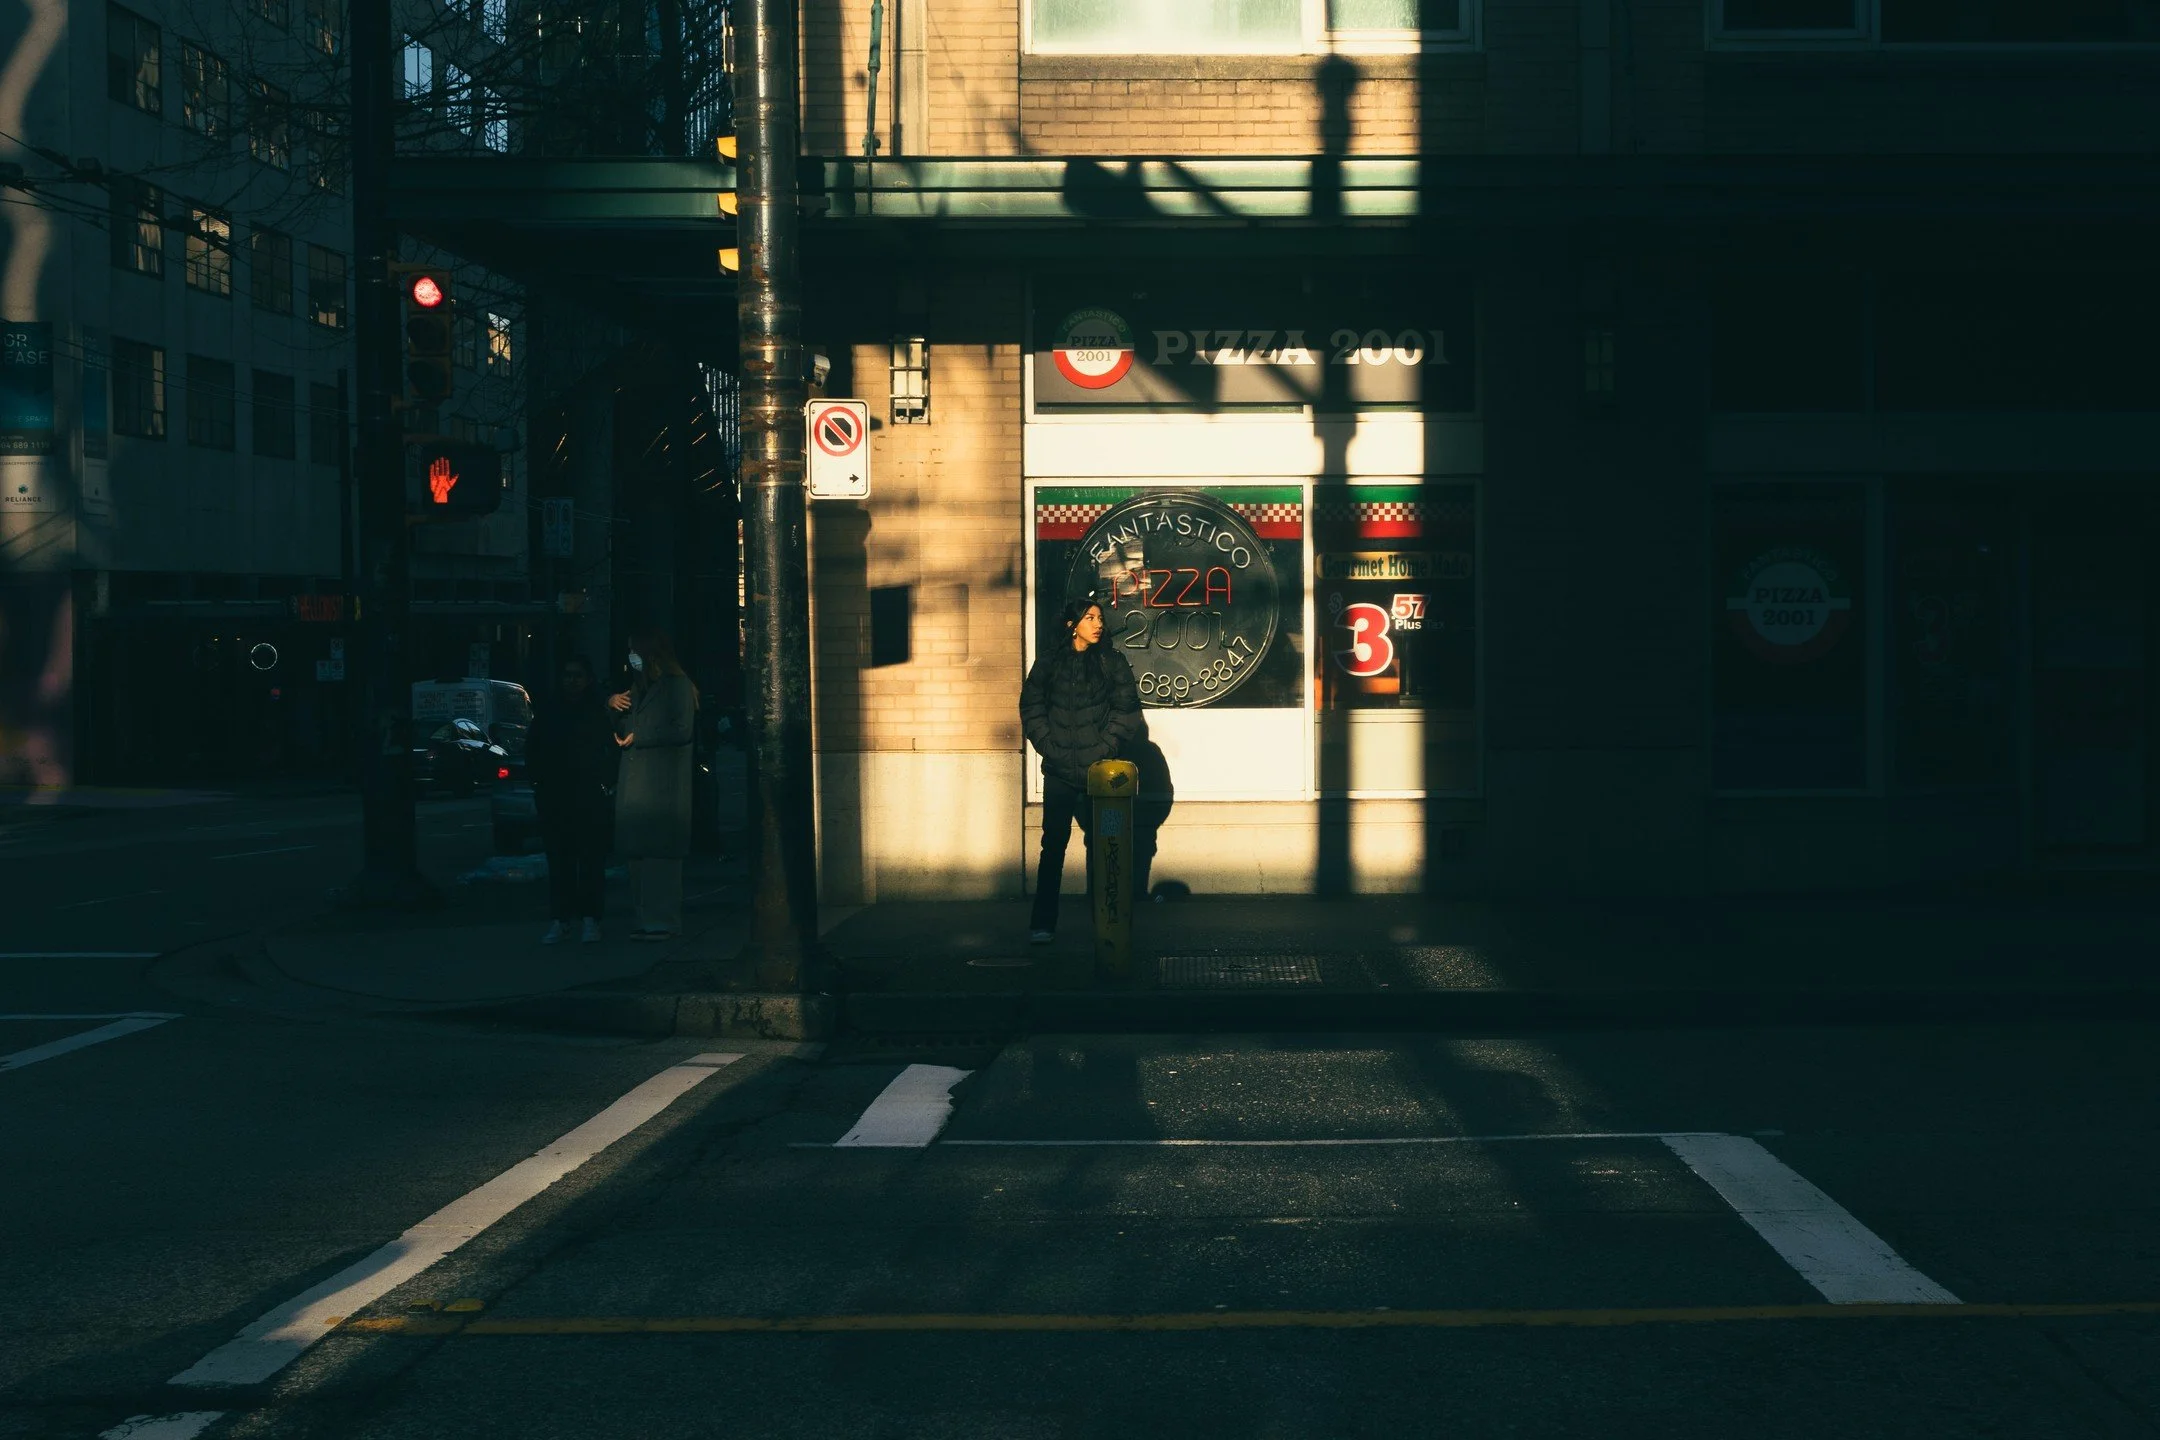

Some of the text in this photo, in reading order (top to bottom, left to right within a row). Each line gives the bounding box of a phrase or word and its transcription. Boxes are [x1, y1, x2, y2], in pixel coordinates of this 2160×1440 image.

[1062, 310, 1126, 333] FANTASTICO
[1071, 336, 1118, 347] PIZZA
[1152, 328, 1450, 366] PIZZA 2001
[1077, 351, 1112, 362] 2001
[1089, 511, 1251, 569] FANTASTICO
[1322, 553, 1468, 577] Gourmet Home Made
[1111, 566, 1232, 609] PIZZA
[1752, 588, 1825, 603] PIZZA
[1395, 619, 1446, 631] Plus Tax
[1763, 609, 1815, 627] 2001
[1123, 609, 1222, 651] 2001
[1138, 635, 1254, 699] 689-8847
